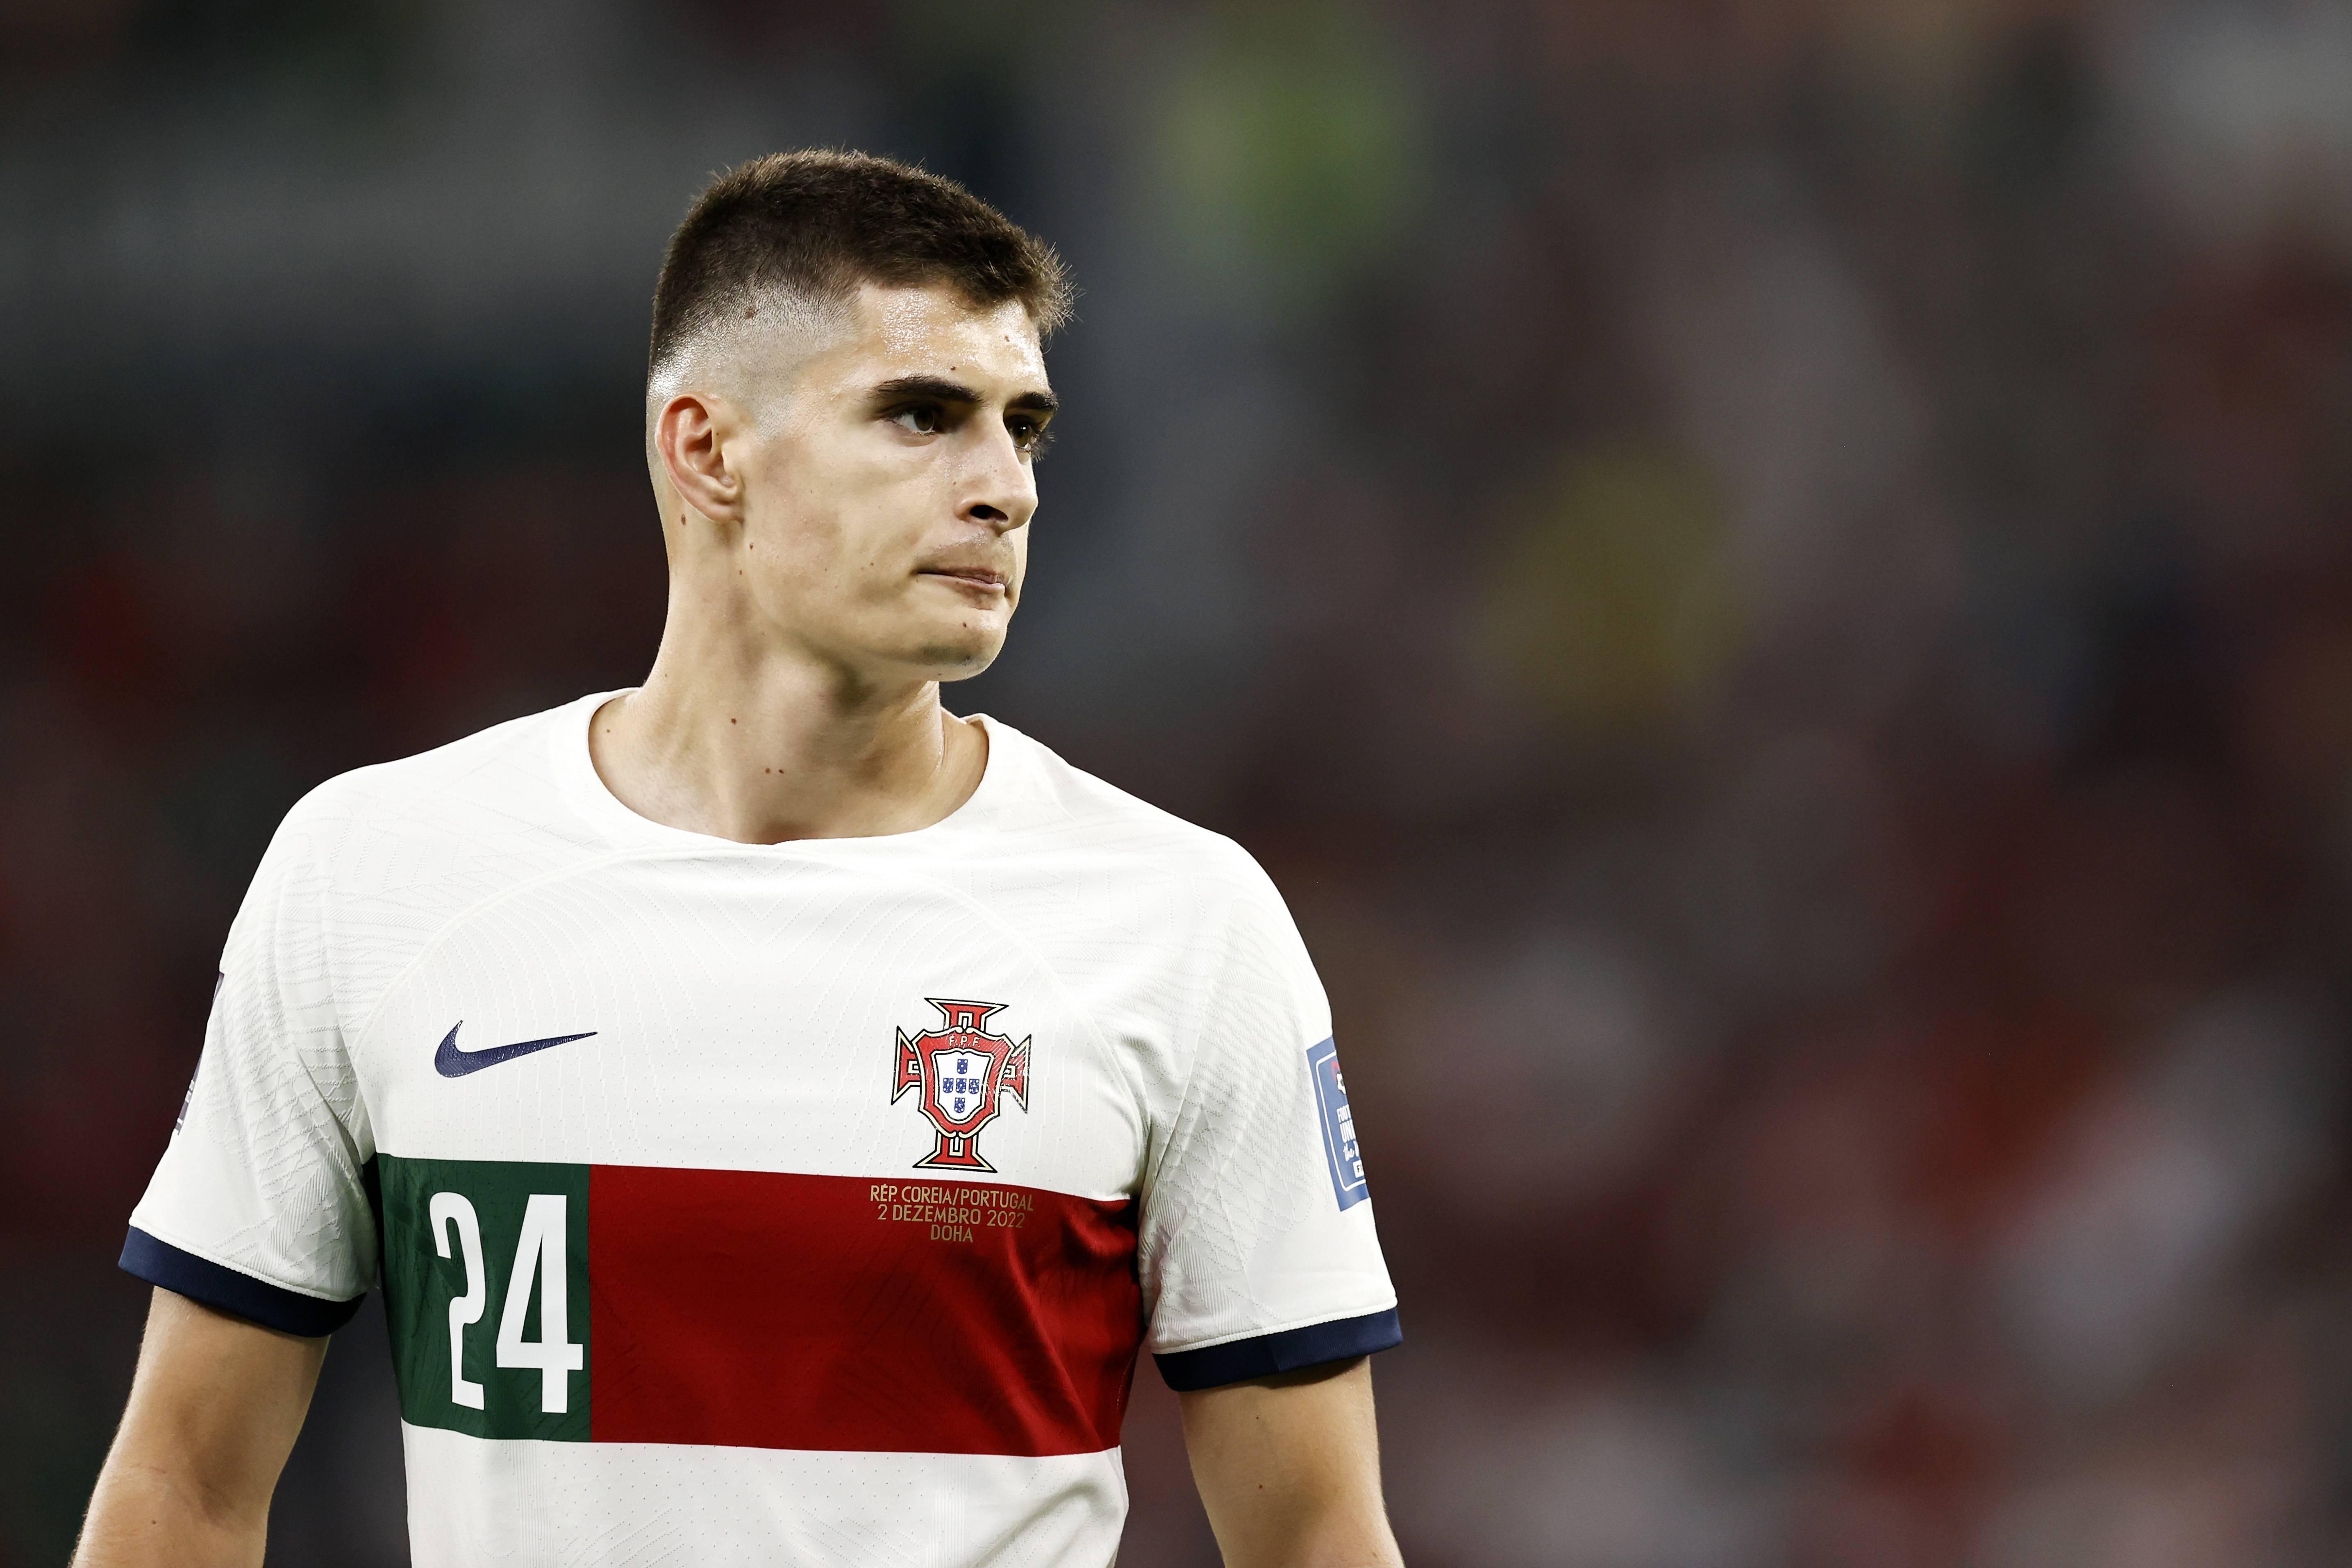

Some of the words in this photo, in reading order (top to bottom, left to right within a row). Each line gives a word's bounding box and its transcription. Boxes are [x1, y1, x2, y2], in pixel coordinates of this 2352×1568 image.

[949, 1035, 980, 1048] F.P.F.
[870, 1184, 897, 1202] RÉP.
[902, 1185, 1033, 1211] COREIA/PORTUGAL
[877, 1204, 888, 1220] 2
[892, 1204, 981, 1225] DEZEMBRO
[986, 1210, 1025, 1228] 2022
[931, 1224, 973, 1243] DOHA
[429, 1191, 583, 1413] 24
